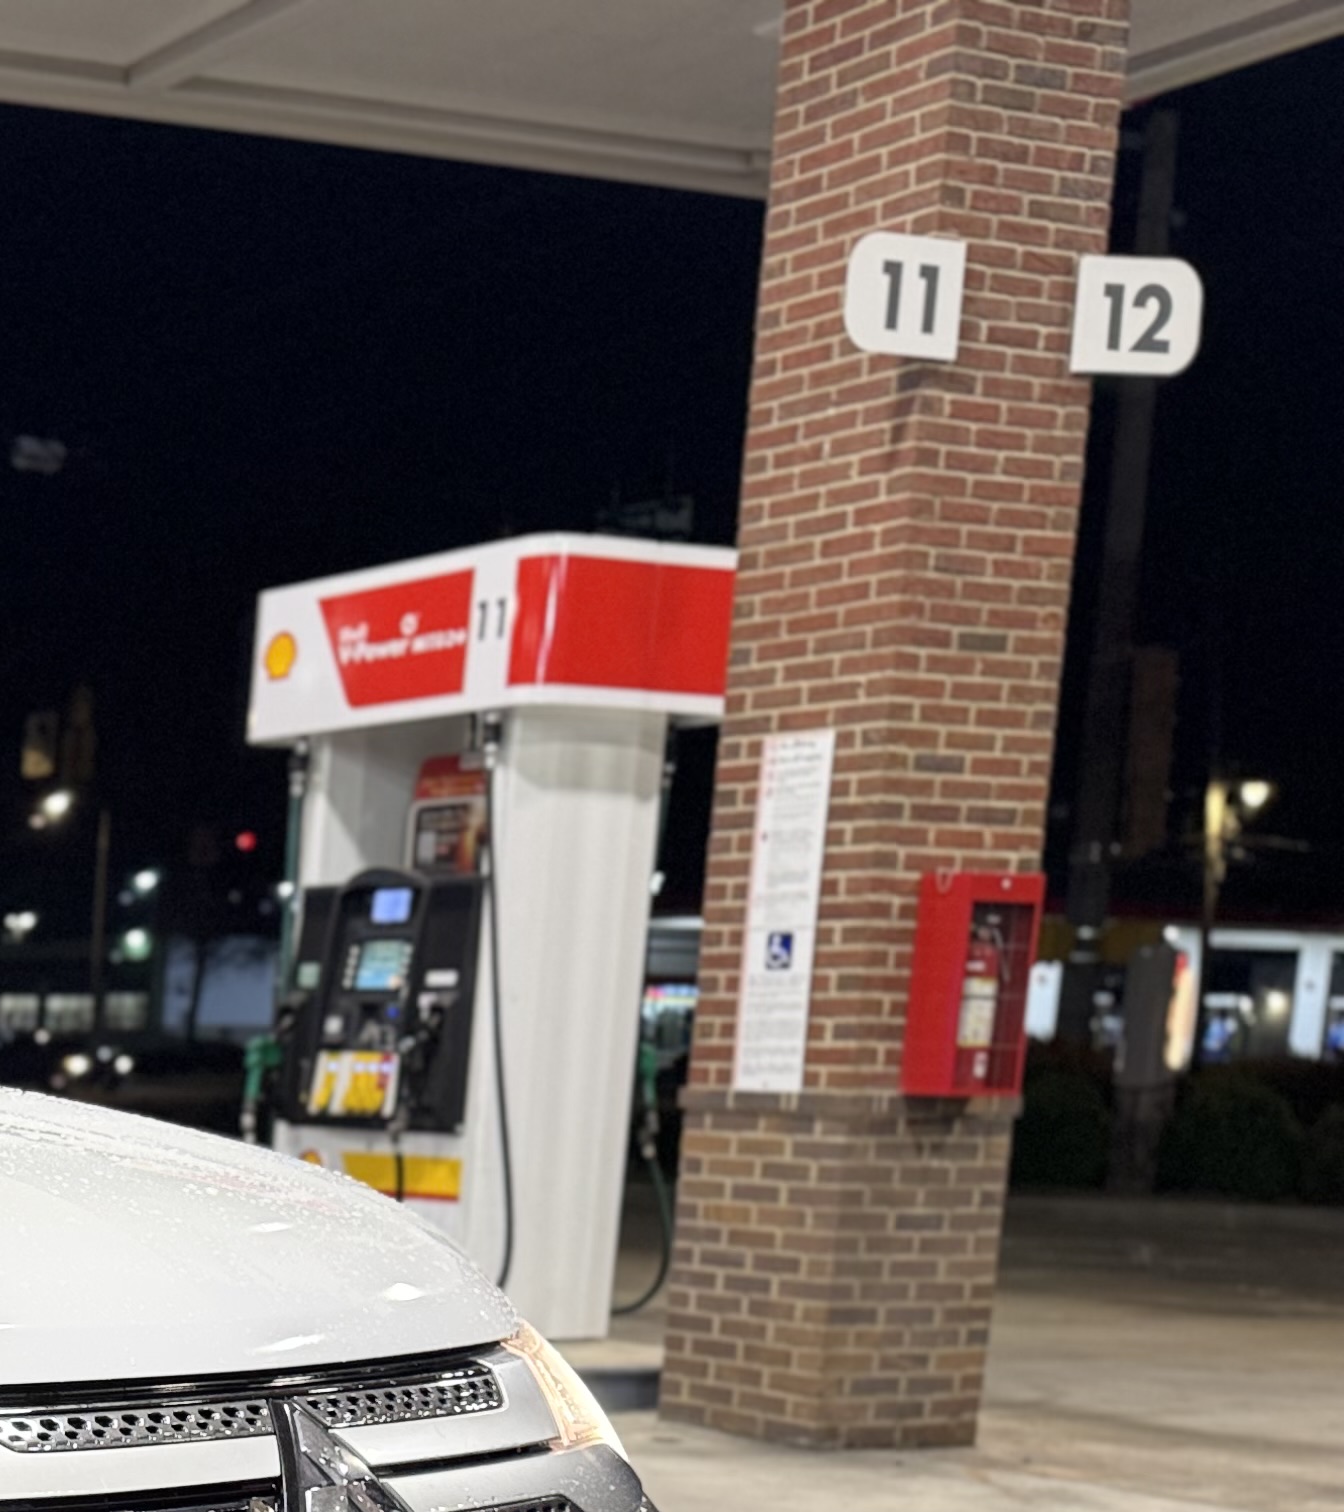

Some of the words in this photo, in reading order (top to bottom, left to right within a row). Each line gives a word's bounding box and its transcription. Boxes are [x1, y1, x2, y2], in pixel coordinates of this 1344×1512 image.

[881, 259, 941, 335] 11
[1103, 282, 1174, 355] 12
[478, 597, 508, 642] 11
